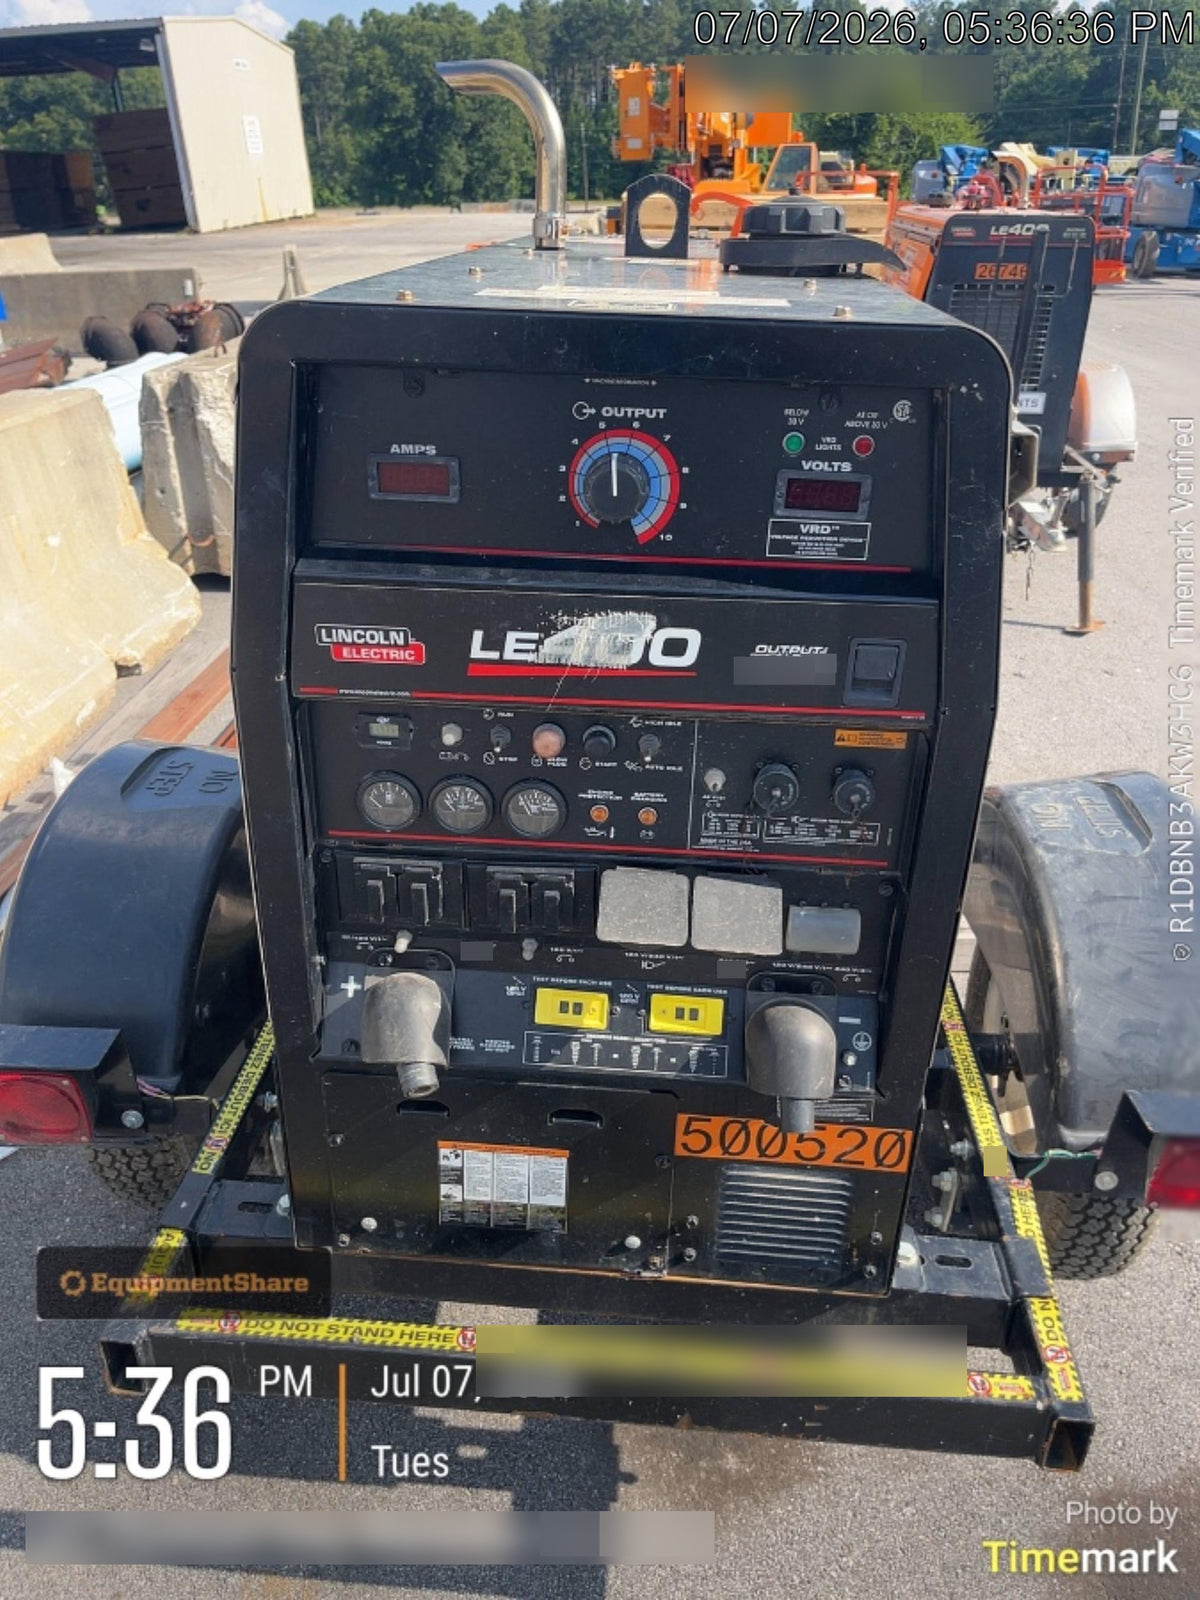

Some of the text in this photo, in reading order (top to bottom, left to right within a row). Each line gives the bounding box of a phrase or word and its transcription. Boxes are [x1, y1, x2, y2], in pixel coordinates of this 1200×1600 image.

[601, 406, 667, 419] OUTPUT
[390, 444, 437, 455] AMPS
[815, 443, 842, 451] LIGHTS
[801, 460, 853, 472] VOLTS
[321, 628, 405, 646] LINCOLN
[342, 647, 415, 661] ELECTRIC
[680, 1116, 907, 1169] 500520
[245, 1320, 456, 1344] DO NOT STAND HERE
[1035, 1315, 1060, 1342] DO
